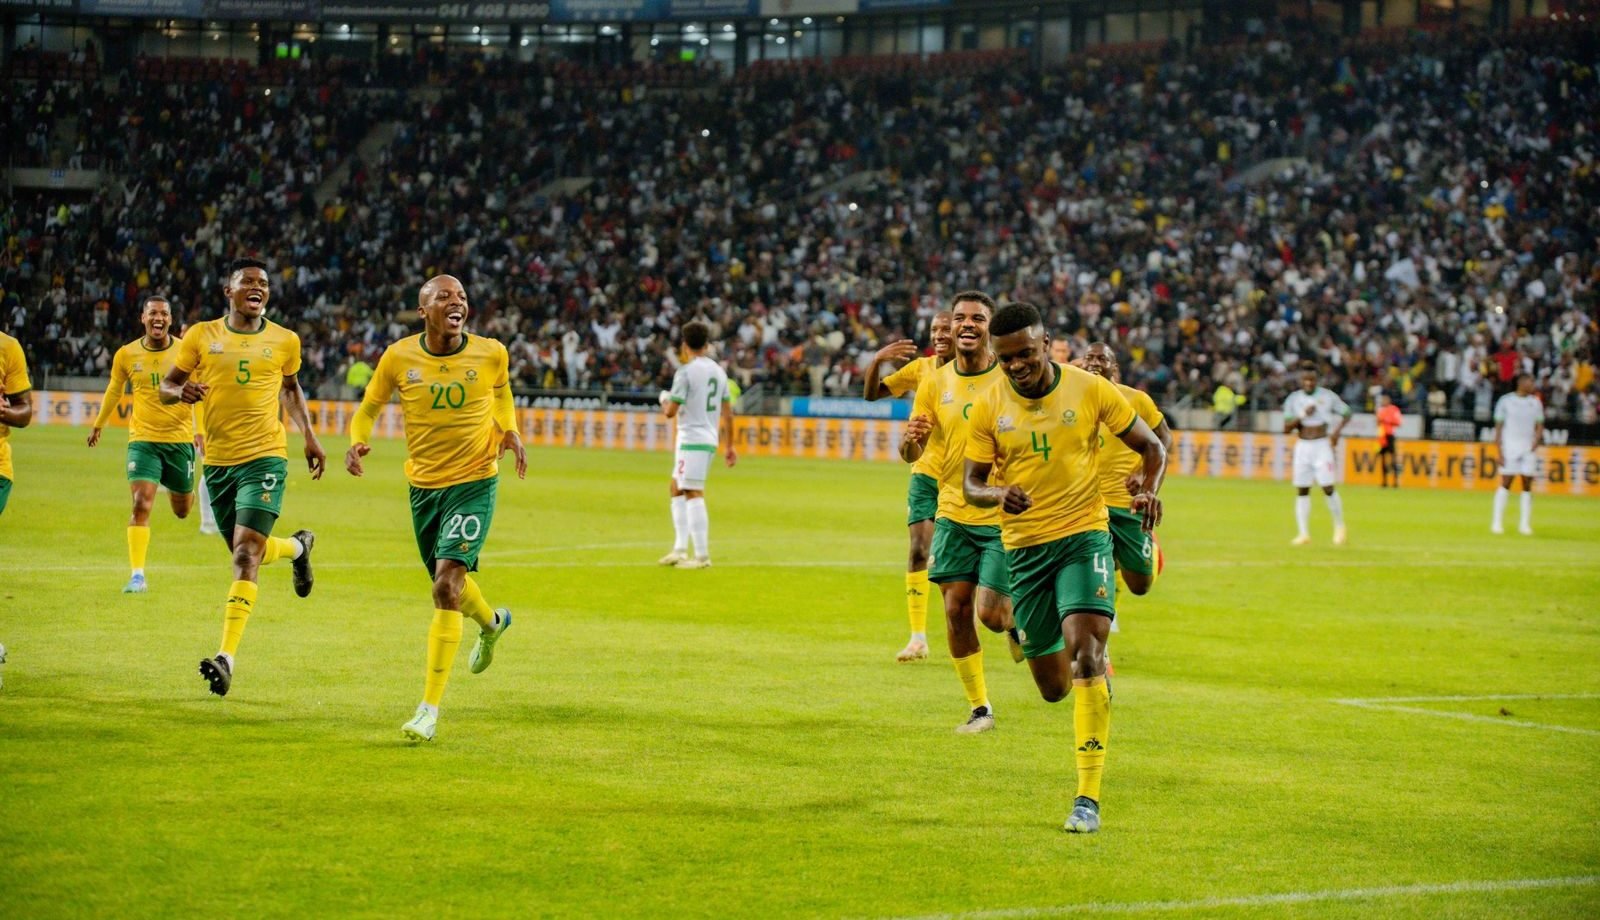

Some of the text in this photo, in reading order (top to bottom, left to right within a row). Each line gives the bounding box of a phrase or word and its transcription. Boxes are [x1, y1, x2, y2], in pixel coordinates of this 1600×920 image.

[237, 360, 251, 385] 5
[430, 382, 466, 410] 20
[706, 377, 719, 413] 2
[1031, 431, 1052, 462] 4
[678, 459, 686, 474] 2
[262, 473, 277, 491] 5
[447, 513, 481, 541] 20
[1141, 536, 1152, 558] 6
[1093, 552, 1109, 583] 4
